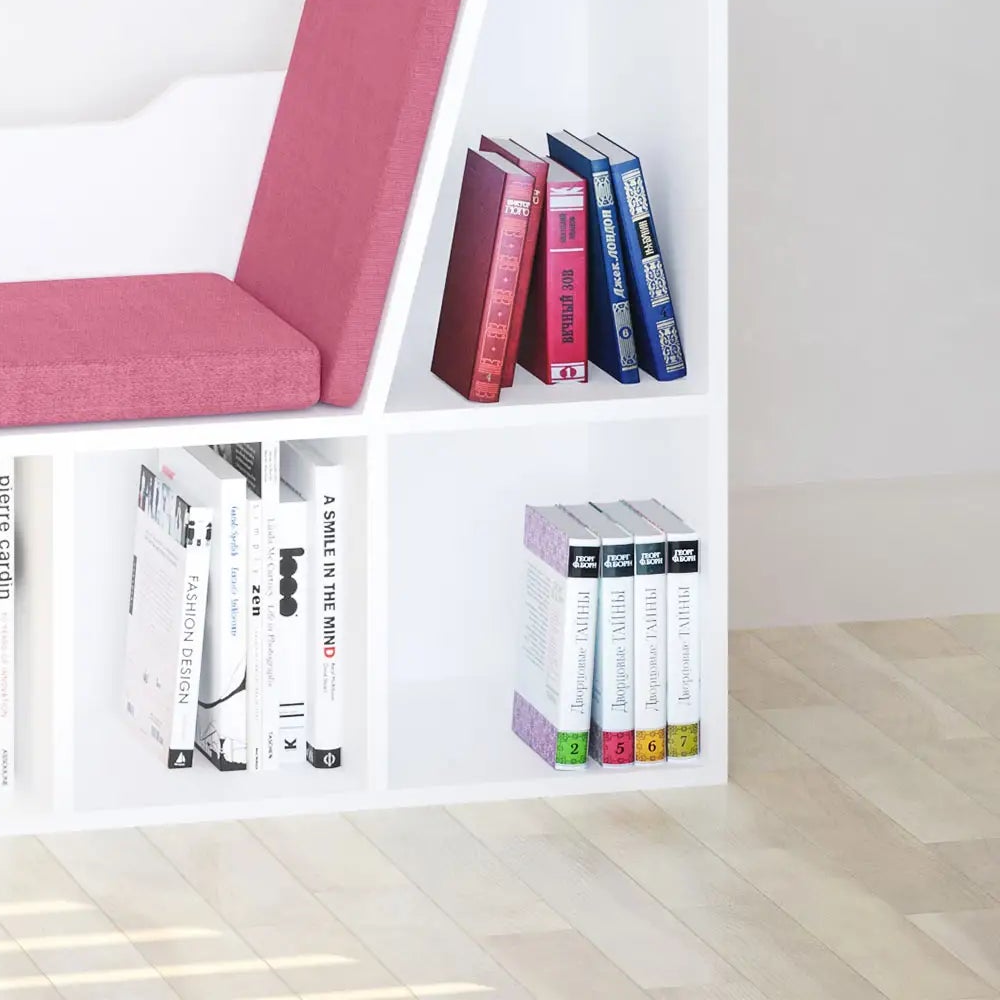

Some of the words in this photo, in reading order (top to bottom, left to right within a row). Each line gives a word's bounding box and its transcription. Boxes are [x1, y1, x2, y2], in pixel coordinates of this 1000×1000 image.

[323, 495, 336, 506] A
[323, 510, 336, 558] SMILE
[606, 553, 630, 561] ГЕОРГ
[640, 551, 661, 559] ГЕОРГ
[673, 548, 694, 556] ГЕОРГ
[323, 562, 336, 578] IN
[252, 584, 261, 617] zen
[323, 582, 336, 612] THE
[183, 575, 199, 643] FASHION
[323, 616, 336, 659] MIND
[178, 647, 194, 705] DESIGN
[284, 738, 297, 750] K
[648, 740, 657, 752] 6
[680, 735, 687, 748] 7
[570, 743, 579, 755] 2
[615, 742, 625, 755] 5
